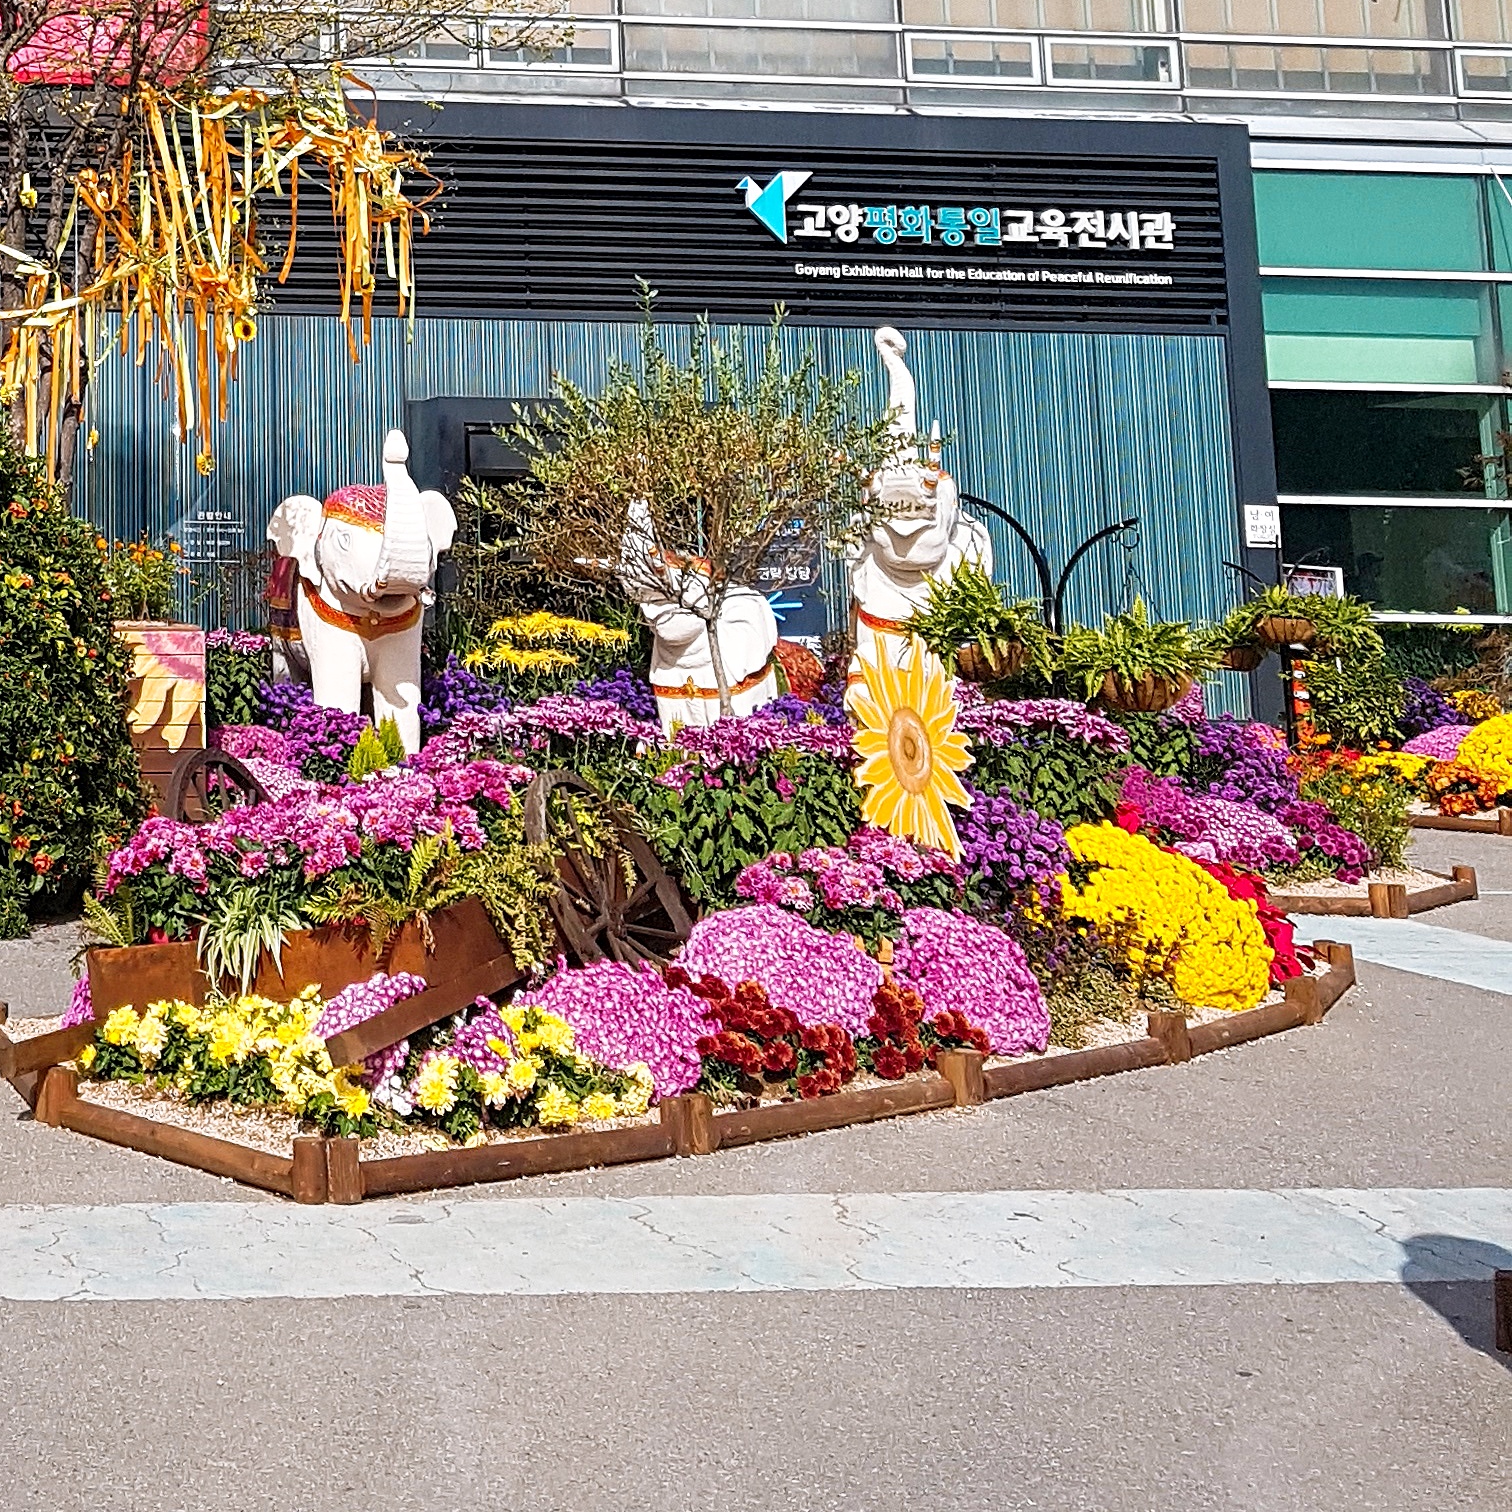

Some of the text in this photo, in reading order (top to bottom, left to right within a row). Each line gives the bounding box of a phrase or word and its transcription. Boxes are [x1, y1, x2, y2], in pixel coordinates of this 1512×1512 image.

[794, 203, 1177, 251] 고양평화통일교육전시관
[794, 263, 1173, 286] Goyang Exhibition Hall for the Education of Peaceful Reunification
